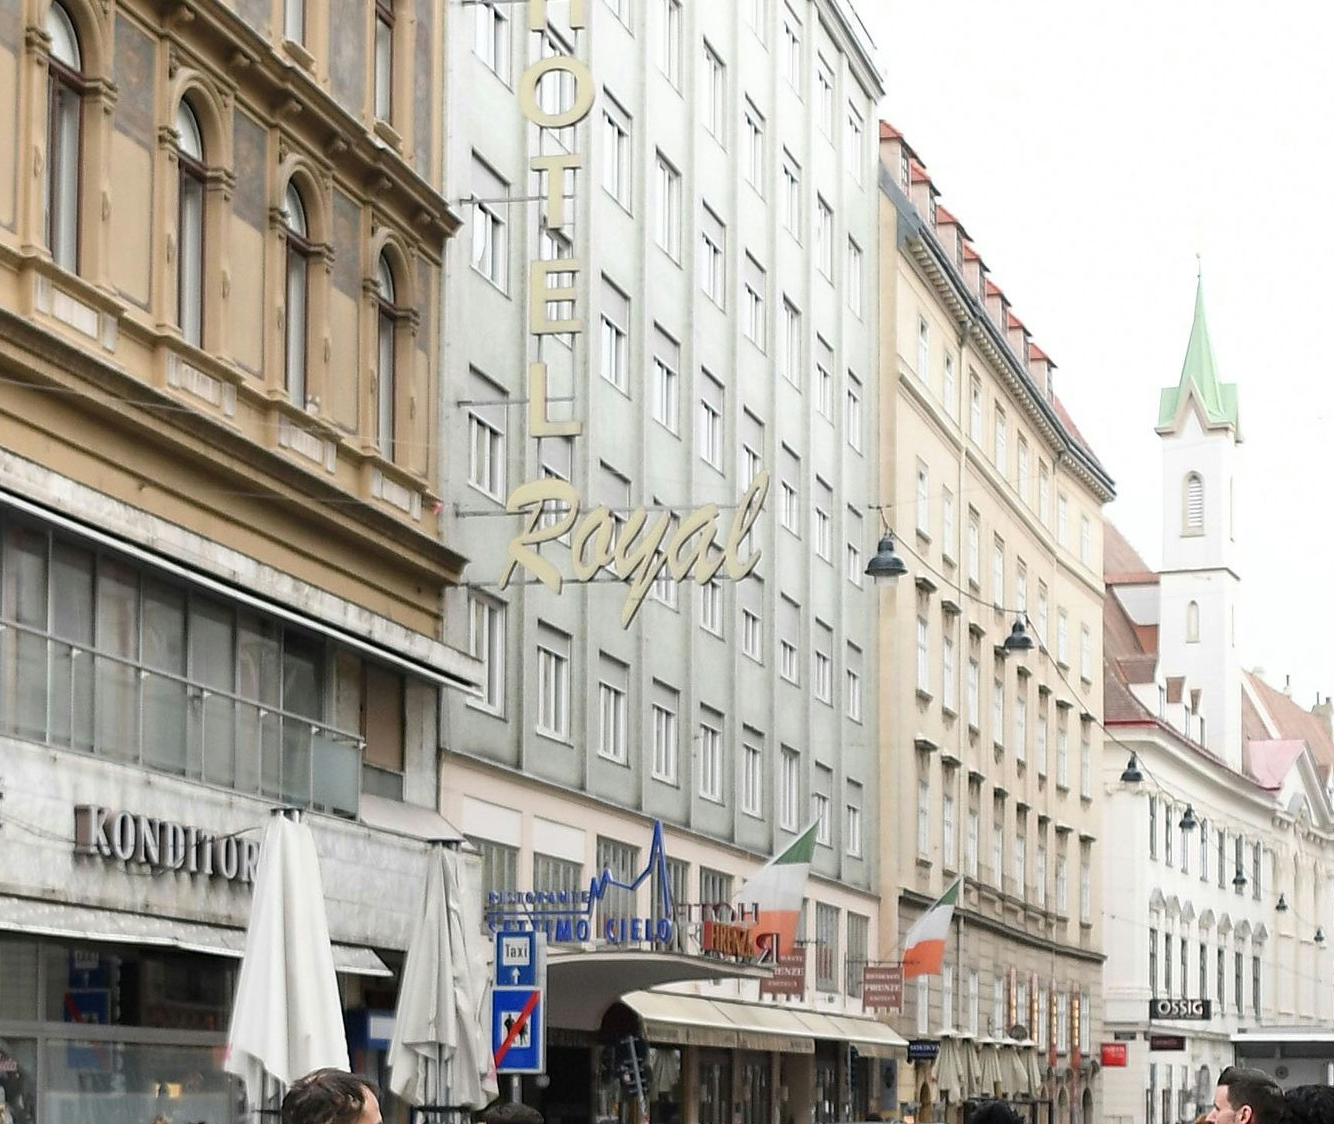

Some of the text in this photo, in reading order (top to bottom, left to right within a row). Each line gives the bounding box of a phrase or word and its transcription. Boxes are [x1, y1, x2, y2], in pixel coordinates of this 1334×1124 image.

[501, 470, 771, 629] Royal
[489, 890, 591, 905] RISTORANTE
[605, 917, 674, 944] CIELO
[505, 944, 528, 958] Taxi
[1158, 1000, 1204, 1015] OSSIG
